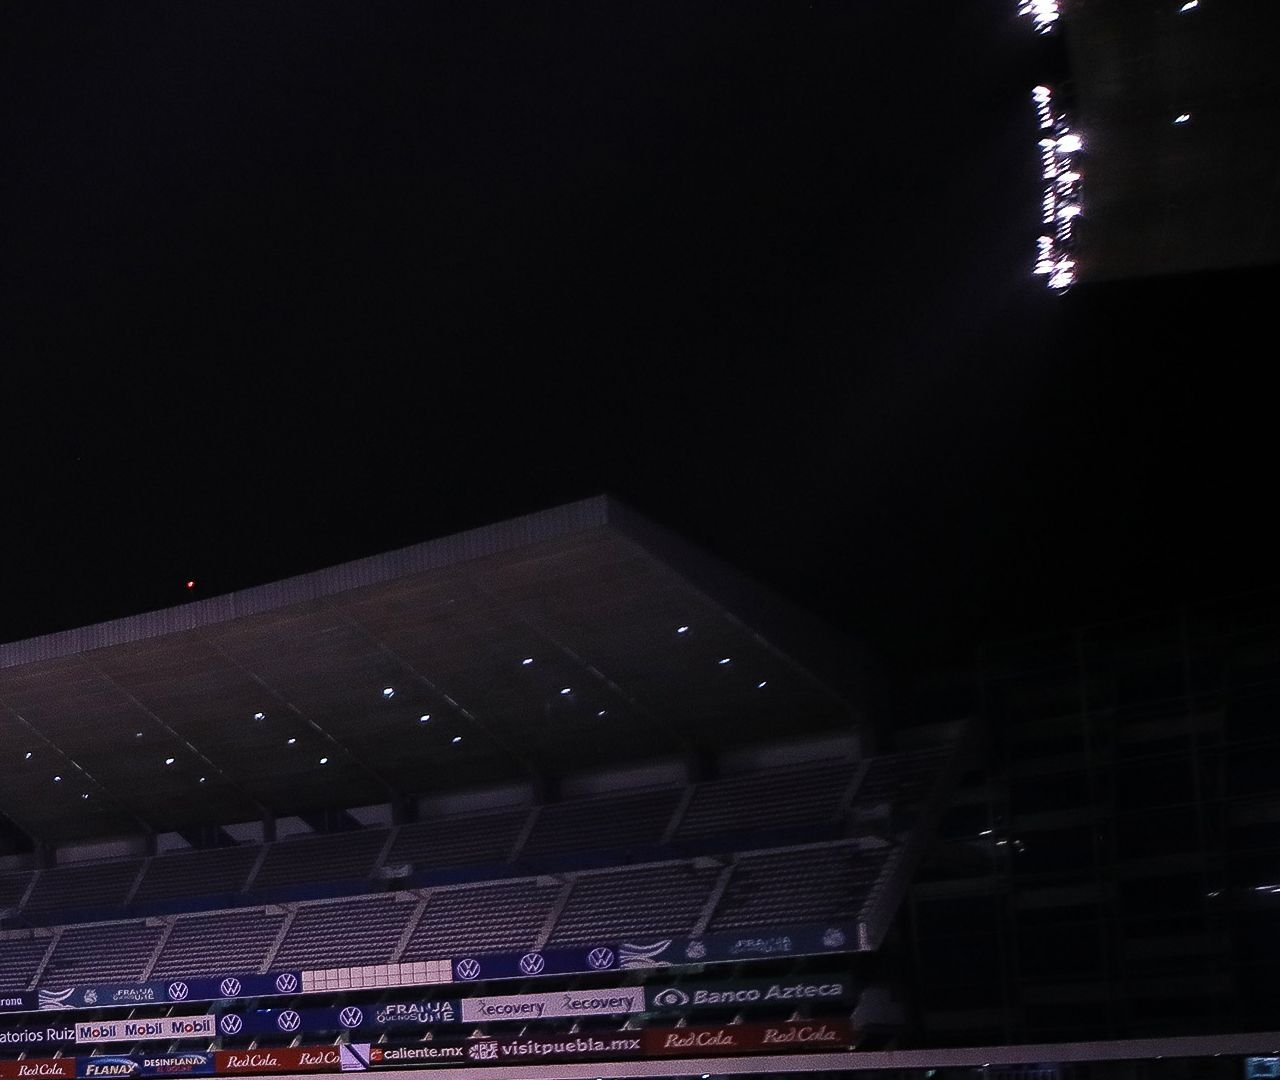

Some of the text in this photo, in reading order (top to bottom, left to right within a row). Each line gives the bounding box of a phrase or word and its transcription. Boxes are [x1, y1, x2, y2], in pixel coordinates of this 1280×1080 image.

[694, 984, 843, 1004] Banco Azteca
[479, 1000, 545, 1015] Recovery
[47, 1029, 75, 1041] Ruiz
[80, 1020, 210, 1037] Mobil Mobil Mobil
[385, 1046, 463, 1059] caliente.mx
[501, 1038, 640, 1056] visitpuebla.mx
[144, 1057, 207, 1067] DESINFLANAX
[86, 1065, 135, 1075] FLANAX
